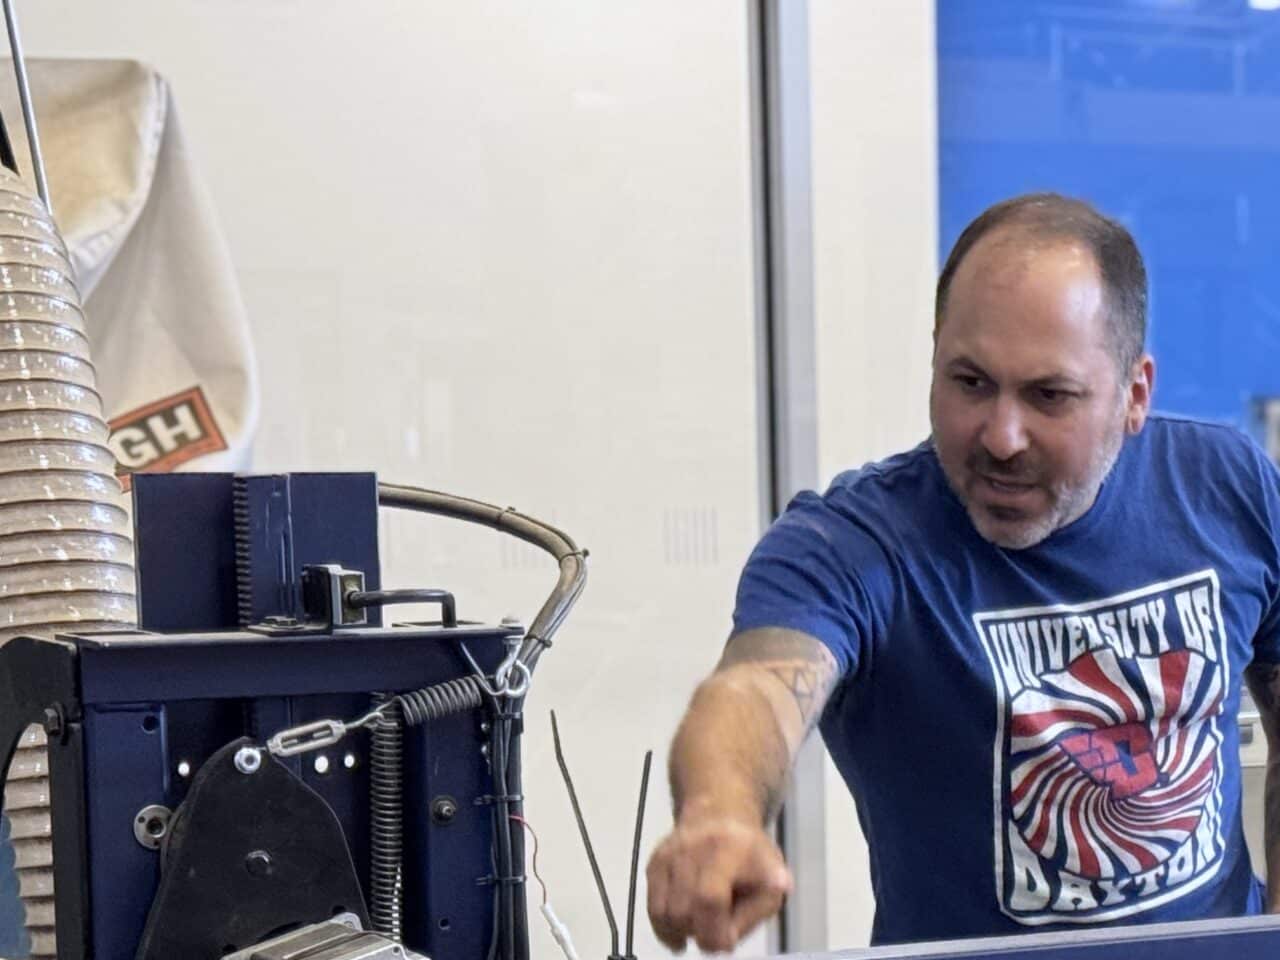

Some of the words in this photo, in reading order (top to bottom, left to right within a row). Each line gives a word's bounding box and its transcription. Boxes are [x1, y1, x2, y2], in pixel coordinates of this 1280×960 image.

[989, 598, 1169, 698] UNIVERSITY
[1175, 586, 1217, 662] OF
[1008, 795, 1216, 911] DAYTON
